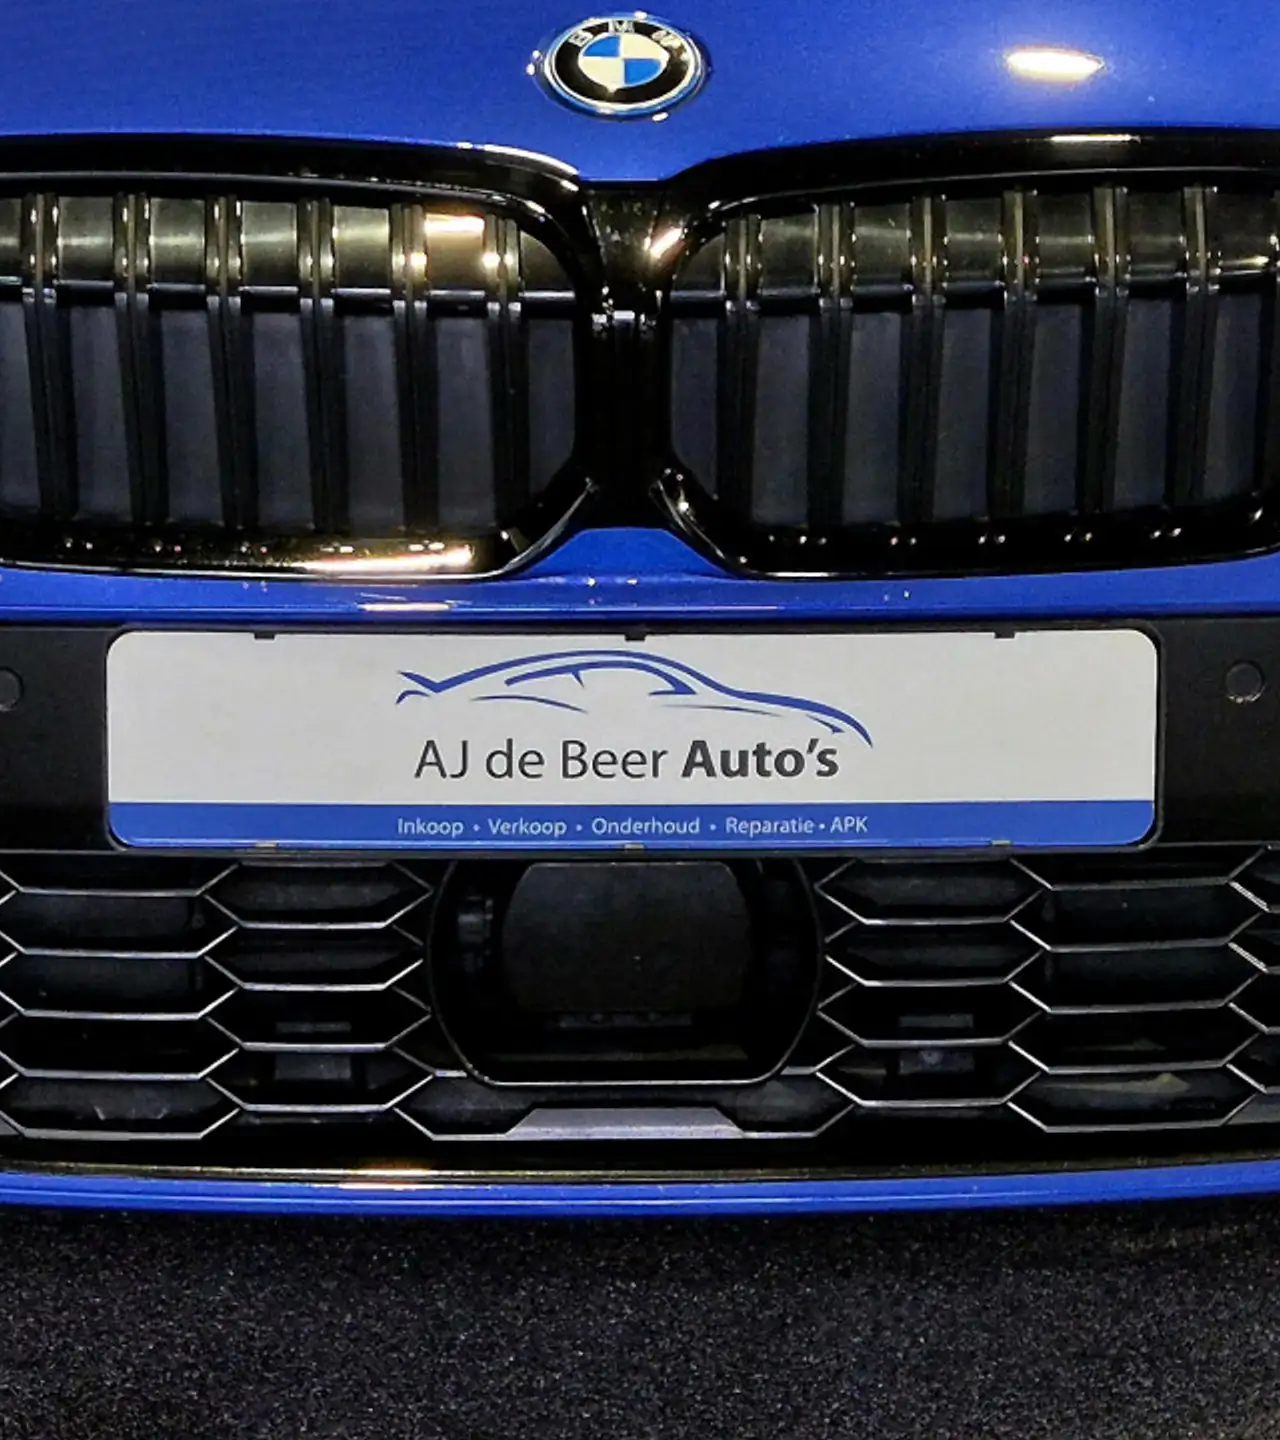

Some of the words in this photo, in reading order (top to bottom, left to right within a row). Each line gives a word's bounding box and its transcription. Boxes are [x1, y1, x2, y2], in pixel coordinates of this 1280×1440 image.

[414, 739, 469, 780] AJ
[485, 737, 545, 780] de
[561, 739, 669, 780] Beer
[681, 737, 840, 780] Auto's
[397, 817, 464, 837] Inkoop
[488, 817, 567, 837] Verkoop
[592, 817, 700, 836] Onderhoud
[726, 817, 815, 837] Reparatie
[830, 816, 868, 834] APK
